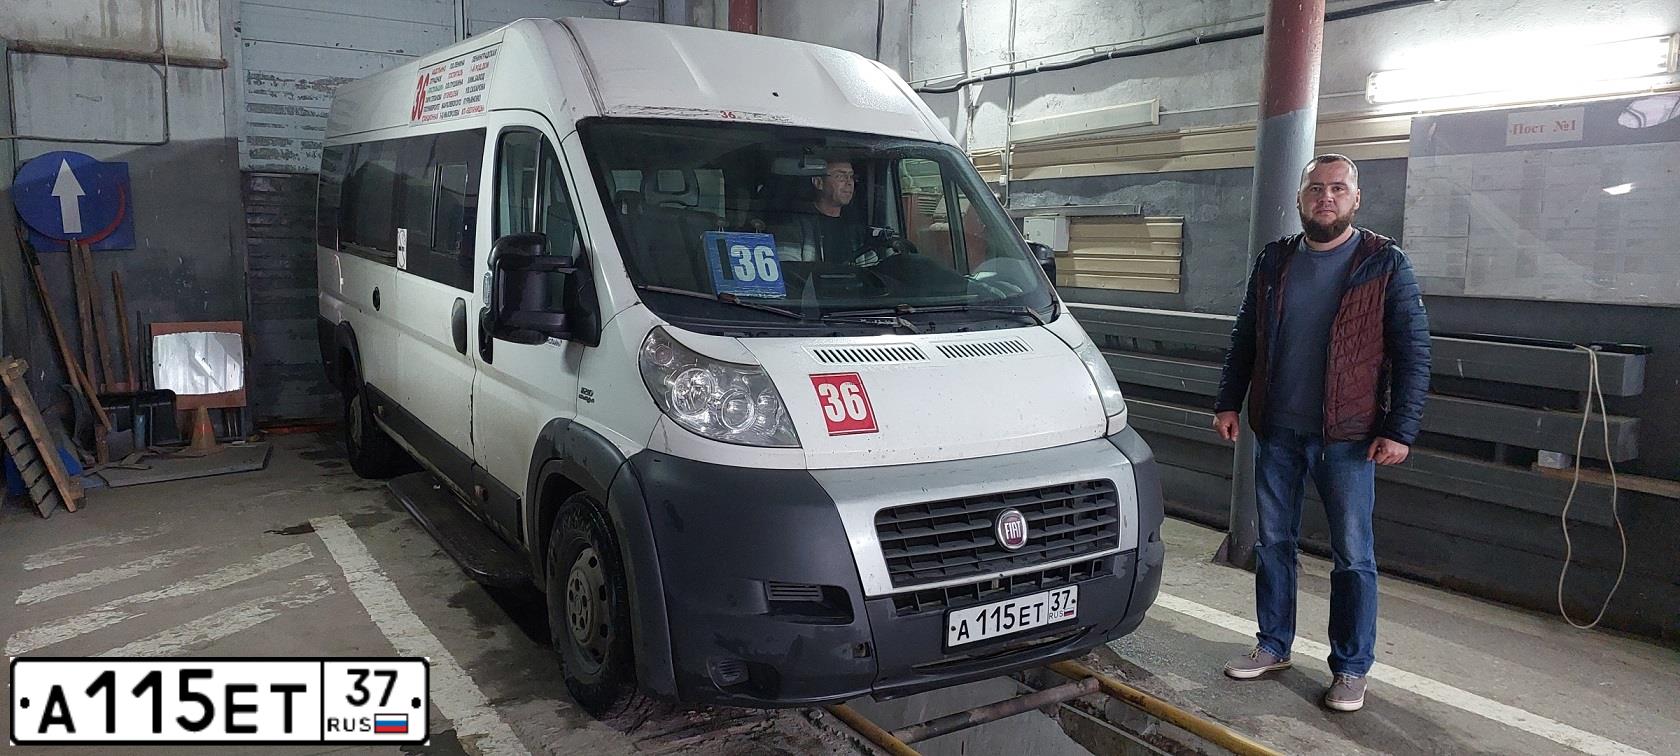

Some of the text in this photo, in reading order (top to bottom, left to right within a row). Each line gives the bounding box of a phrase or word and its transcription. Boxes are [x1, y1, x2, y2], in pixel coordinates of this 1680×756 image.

[412, 73, 430, 121] 36
[720, 110, 736, 119] 36
[1512, 120, 1576, 135] Пост №1
[731, 244, 779, 282] 36
[818, 382, 867, 422] 36
[1004, 521, 1022, 540] FIAT
[1051, 590, 1071, 611] 37
[1049, 610, 1064, 620] RUS
